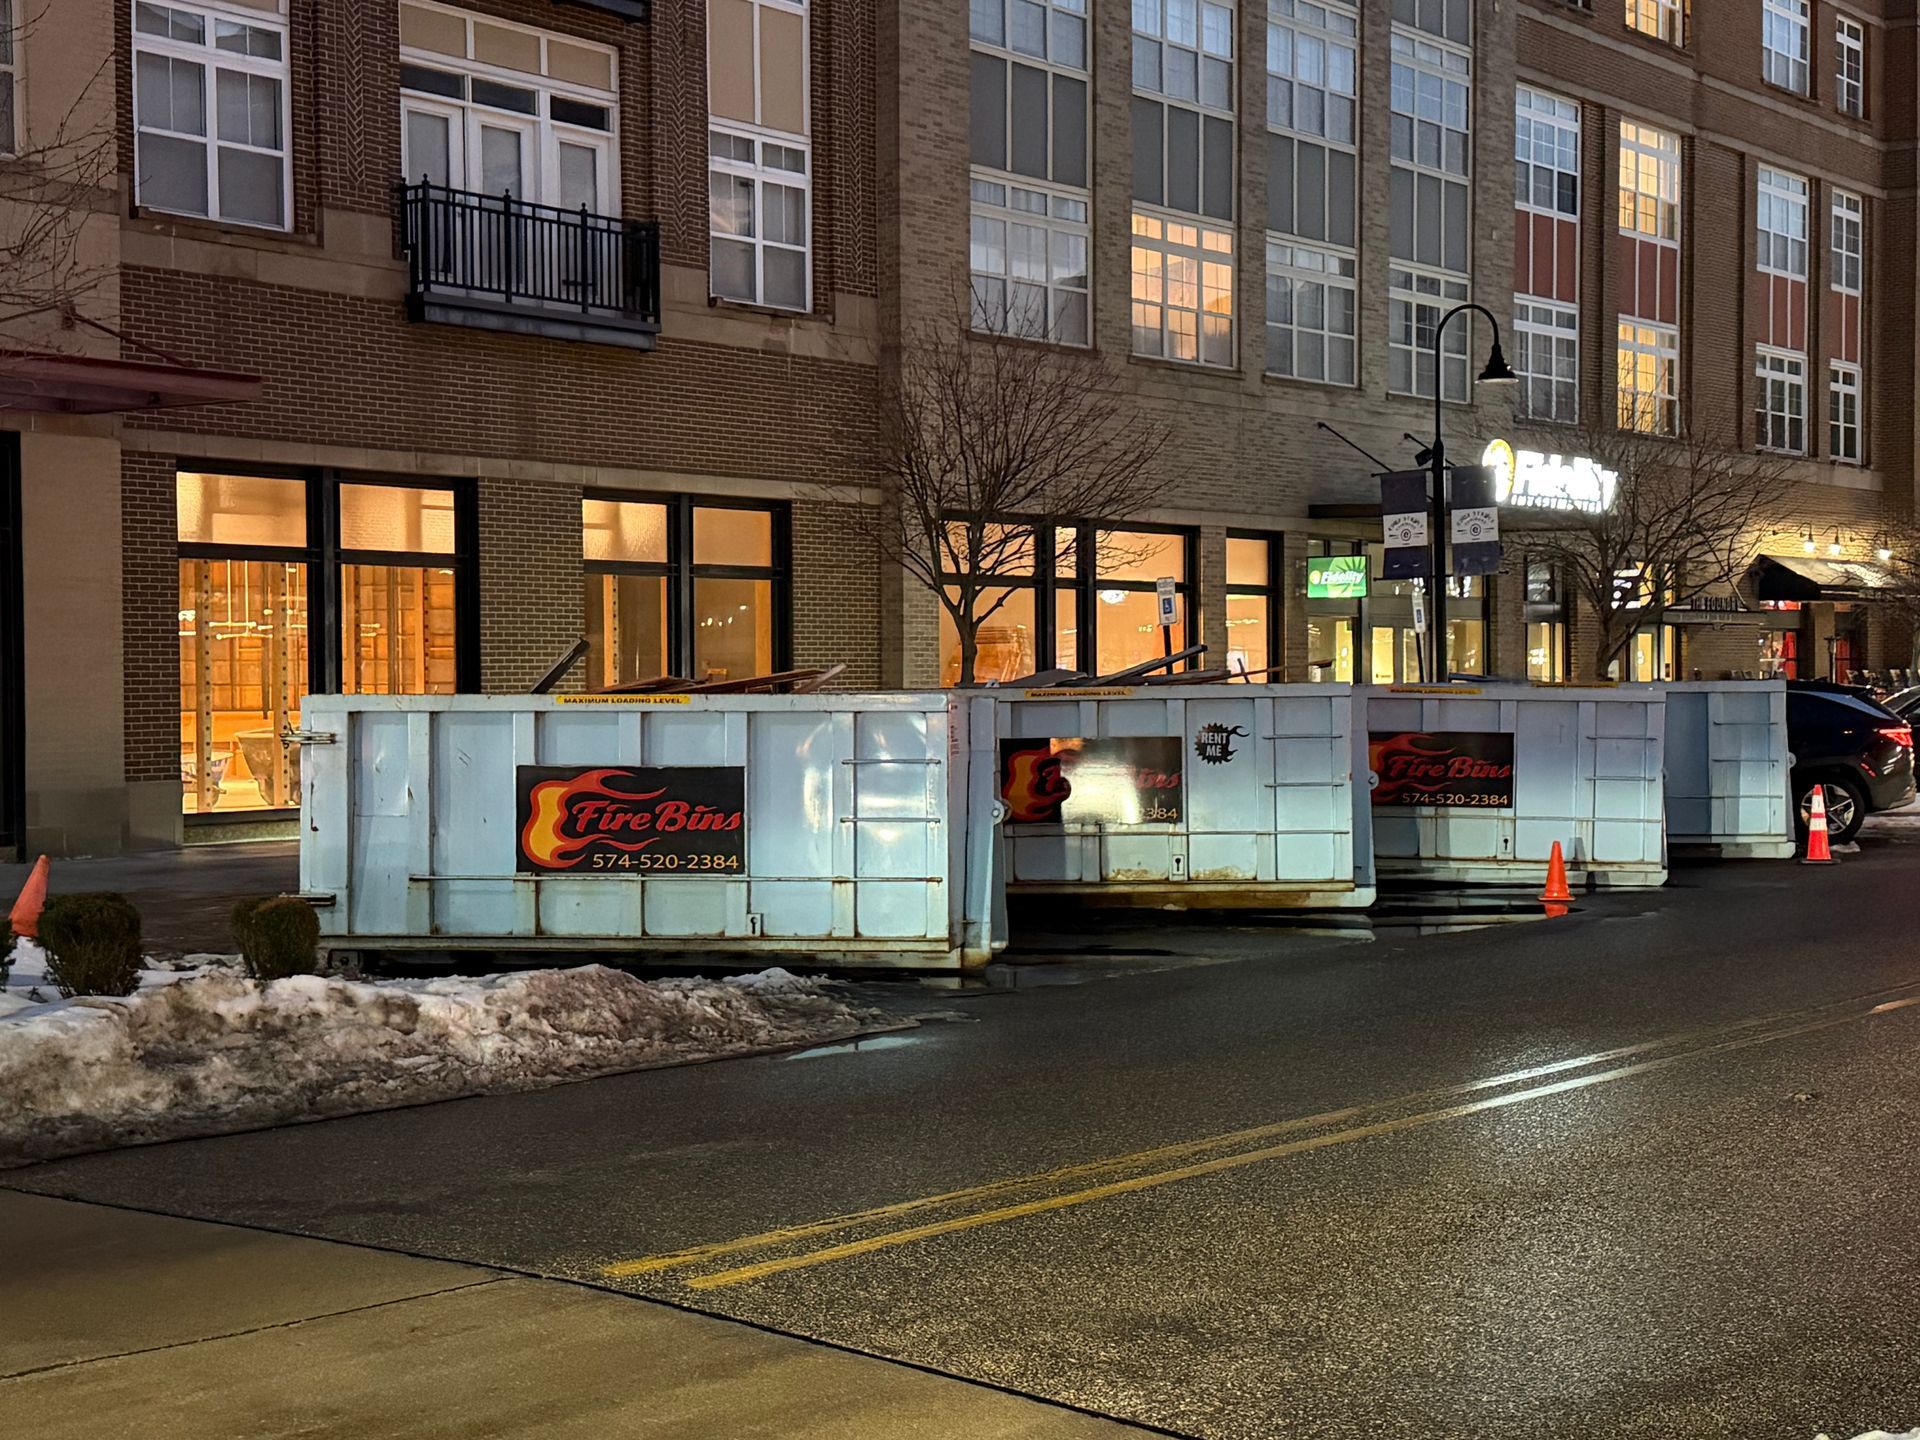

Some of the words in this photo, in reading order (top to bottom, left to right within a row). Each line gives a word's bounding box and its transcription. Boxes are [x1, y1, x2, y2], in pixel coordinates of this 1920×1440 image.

[1201, 732, 1228, 744] RENT
[1206, 745, 1222, 757] ME
[1388, 756, 1445, 778] Fire
[1447, 756, 1511, 778] Bins
[1402, 793, 1509, 806] 574-520-2384
[571, 800, 652, 833] Fire
[655, 800, 742, 832] Bins
[592, 854, 740, 869] 574-520-2384
